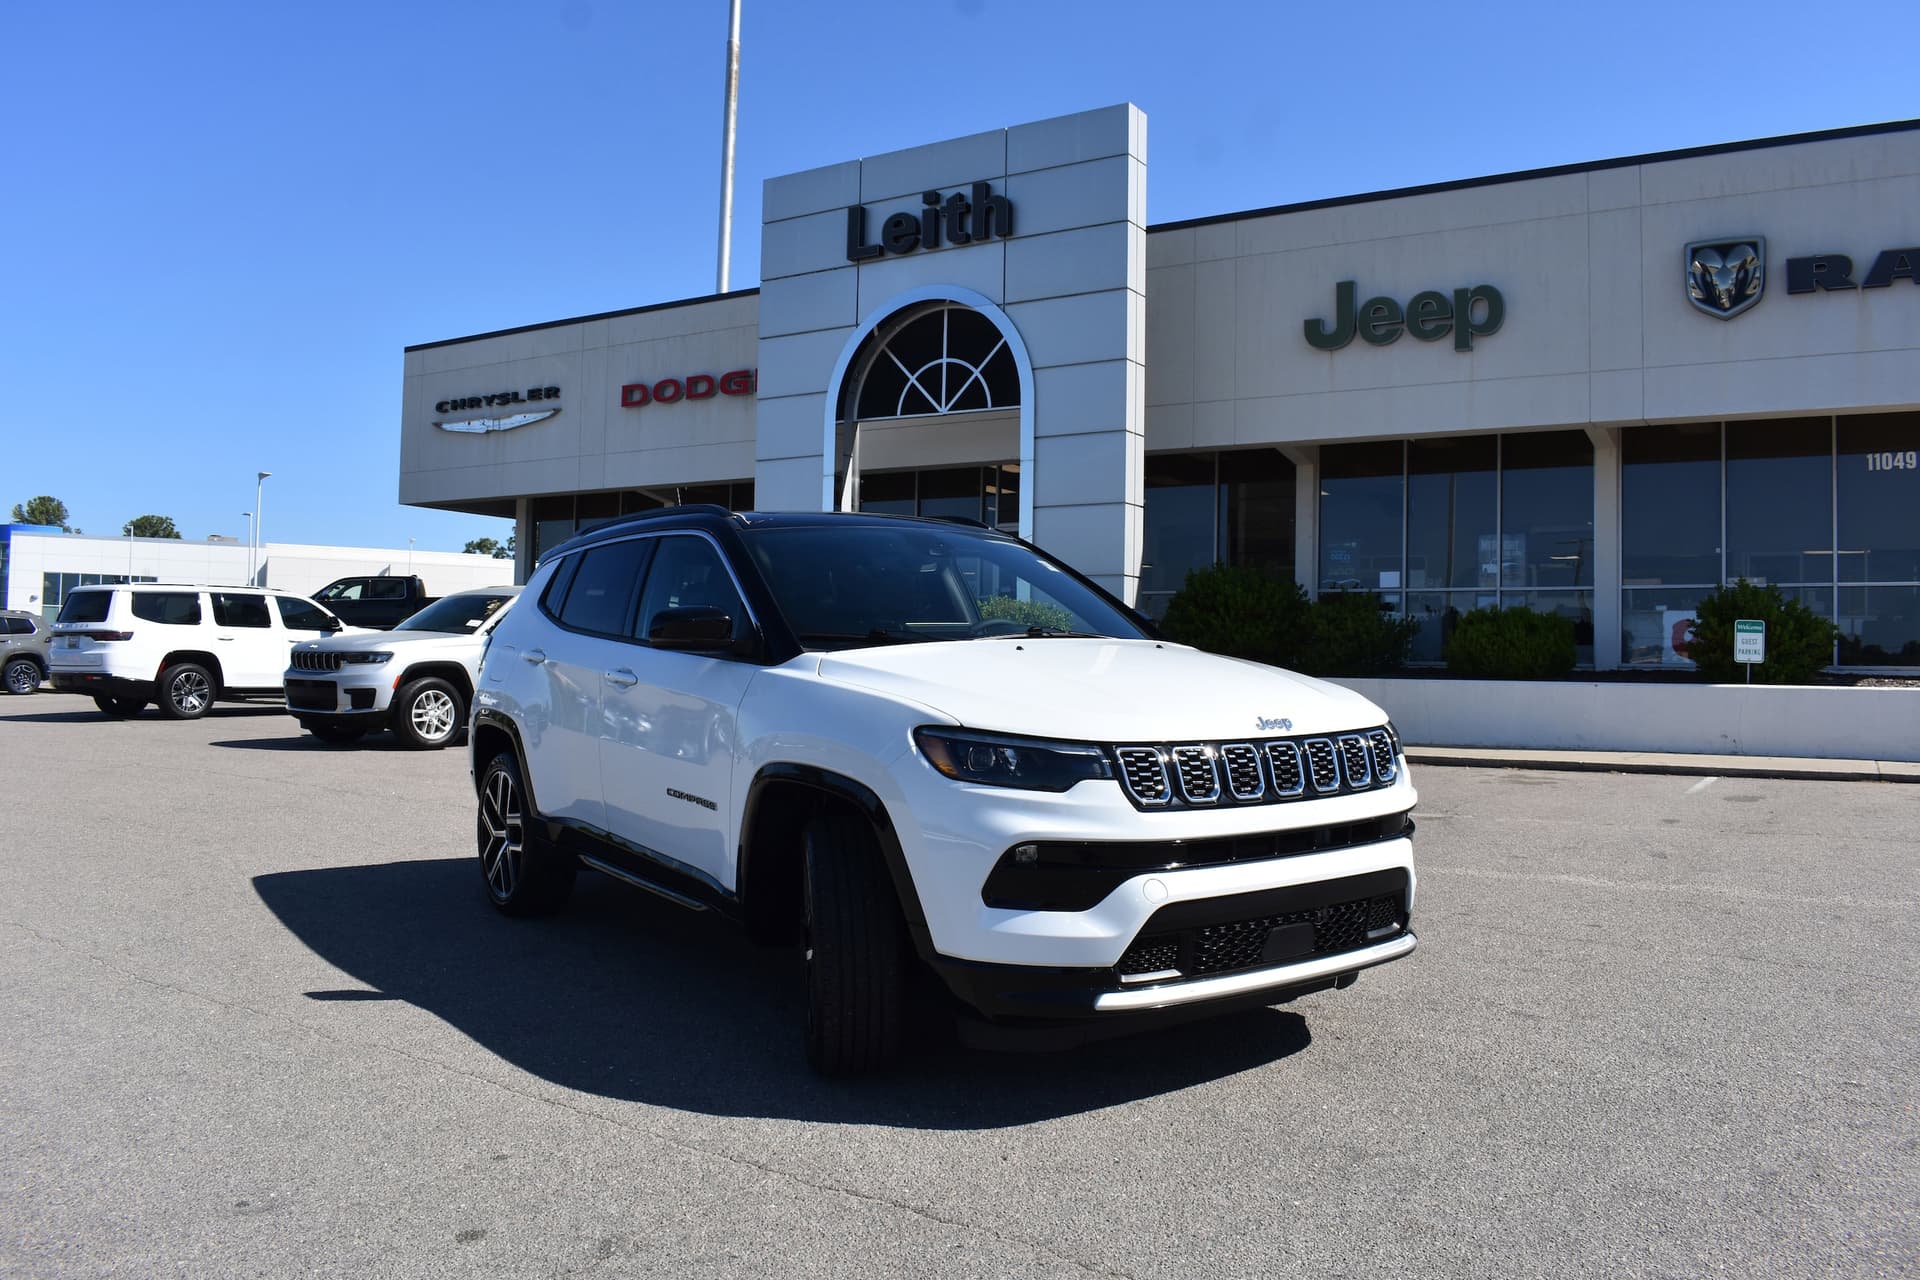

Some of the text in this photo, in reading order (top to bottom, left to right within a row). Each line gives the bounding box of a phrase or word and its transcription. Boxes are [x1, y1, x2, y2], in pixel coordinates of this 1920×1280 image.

[847, 181, 1014, 262] Leith
[1304, 280, 1505, 352] Jeep
[435, 386, 561, 414] CHRYSLER
[621, 367, 758, 408] DODG
[1866, 451, 1917, 471] 11049
[1738, 648, 1761, 656] PARKING
[1256, 716, 1293, 731] Jeep
[666, 787, 719, 811] COMPASS
